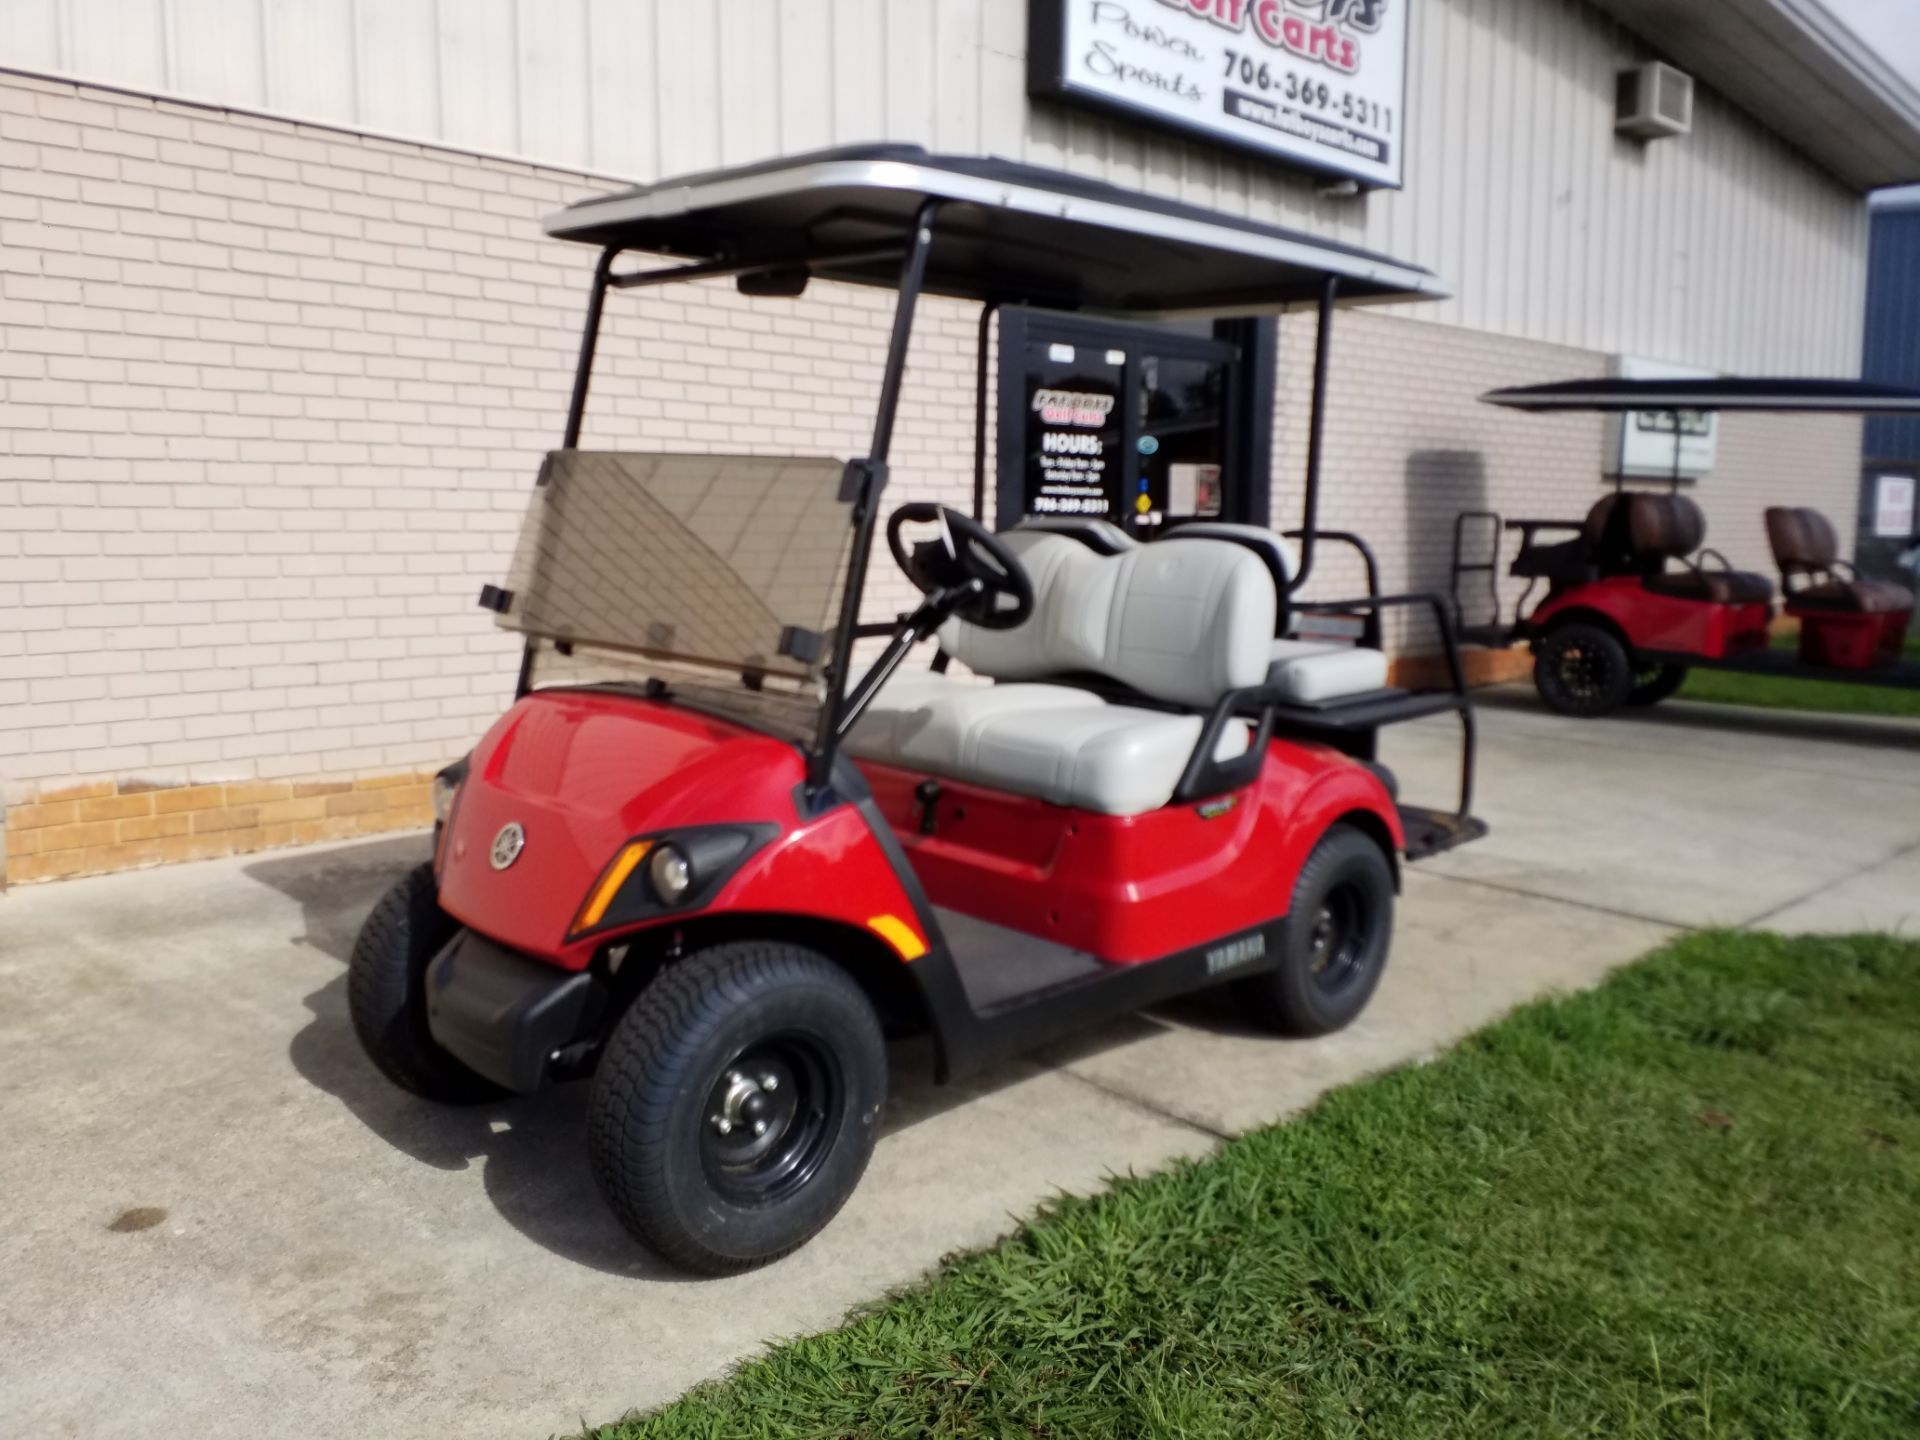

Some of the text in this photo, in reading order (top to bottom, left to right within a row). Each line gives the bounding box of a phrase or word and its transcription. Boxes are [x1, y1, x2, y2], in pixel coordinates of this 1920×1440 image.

[1091, 1, 1204, 60] Power
[1259, 0, 1356, 69] Carts
[1085, 39, 1206, 101] Sports
[1224, 50, 1392, 133] 706-369-5311
